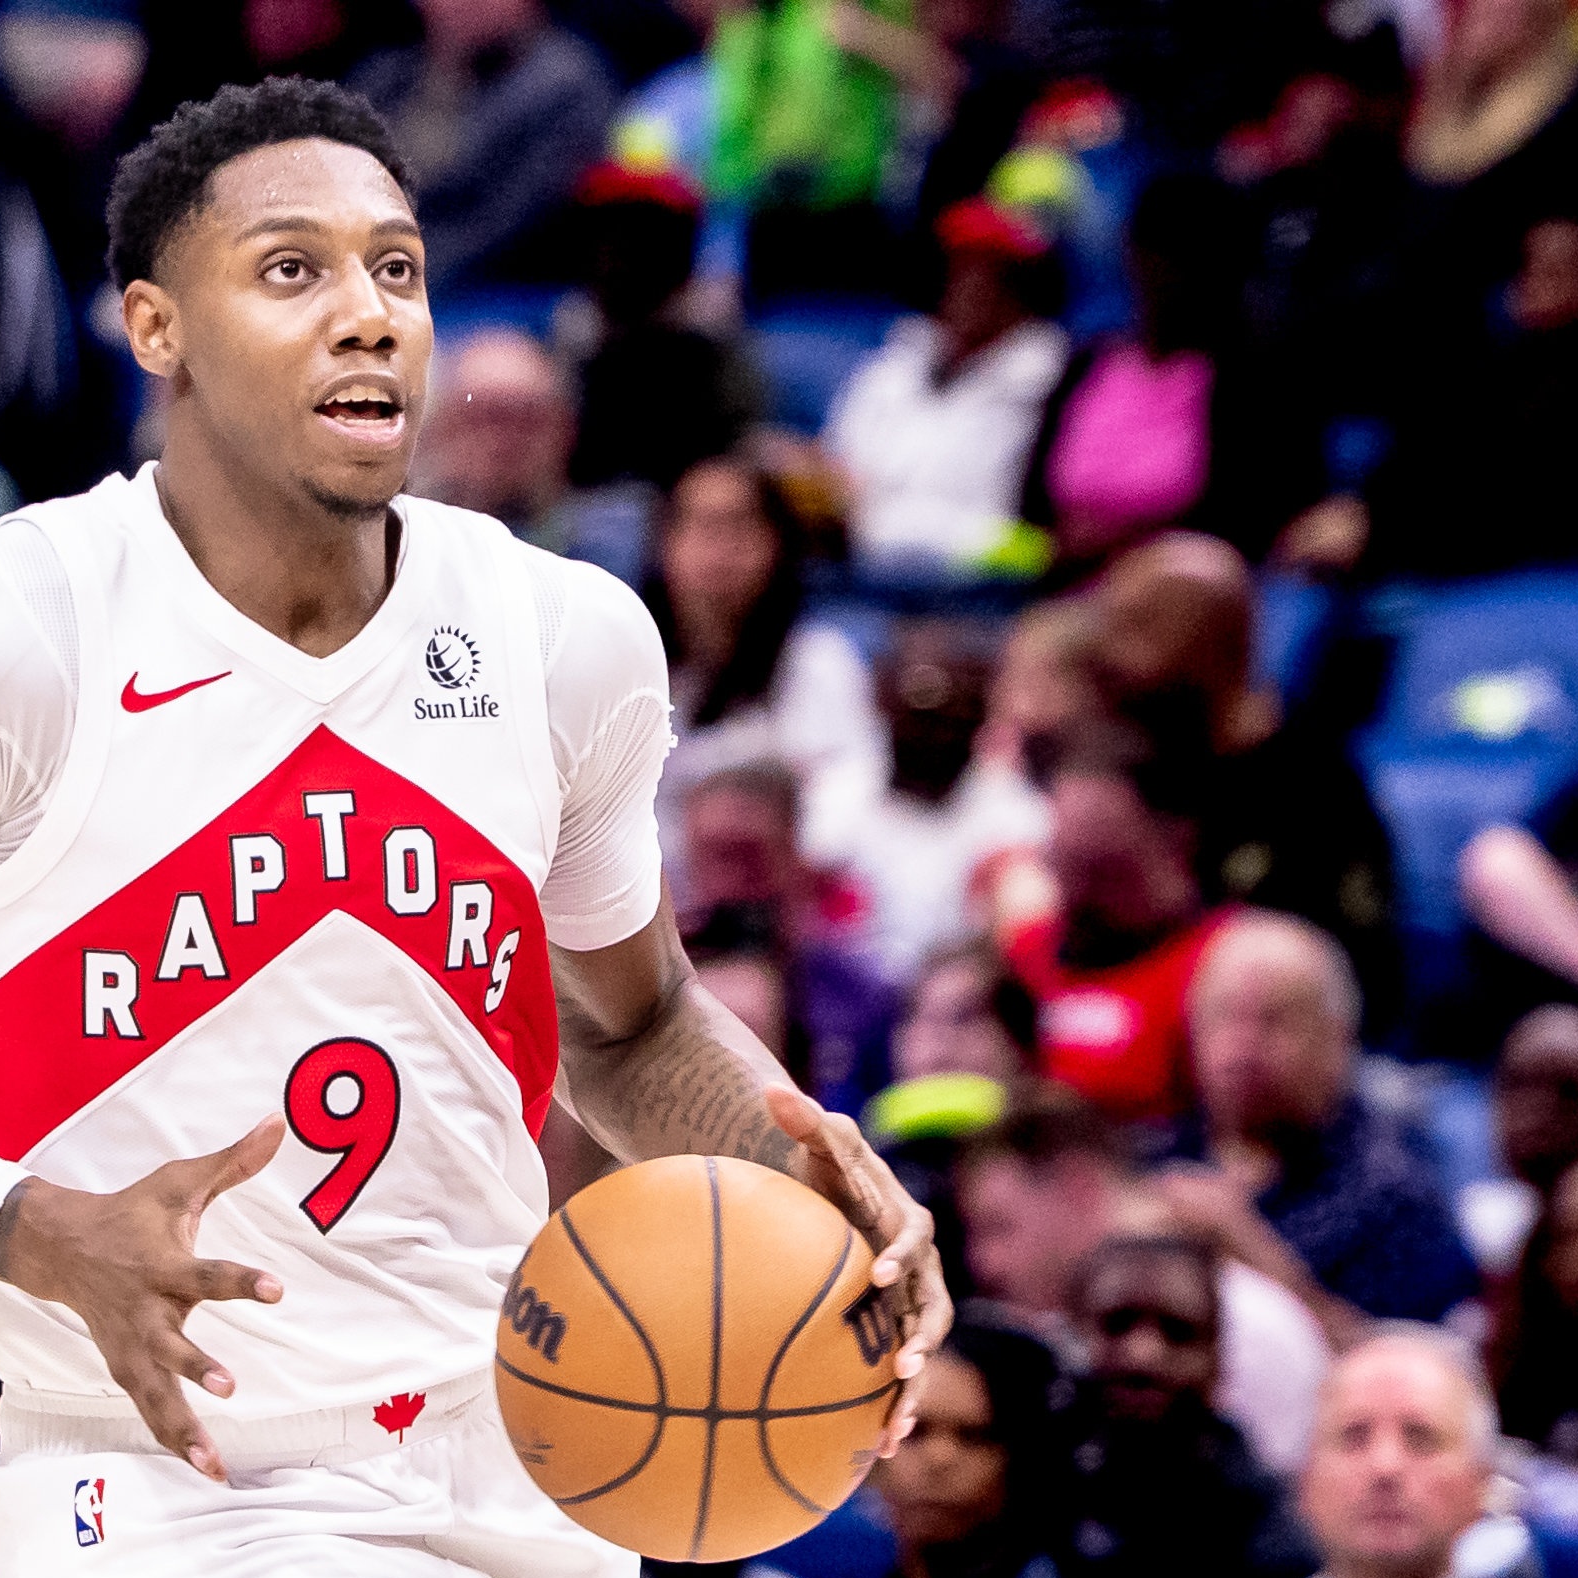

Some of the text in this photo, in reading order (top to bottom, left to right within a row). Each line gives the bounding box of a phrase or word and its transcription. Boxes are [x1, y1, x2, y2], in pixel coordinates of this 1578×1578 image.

[414, 694, 500, 720] Sun Life
[81, 789, 522, 1041] RAPTORS
[284, 1036, 402, 1236] 9
